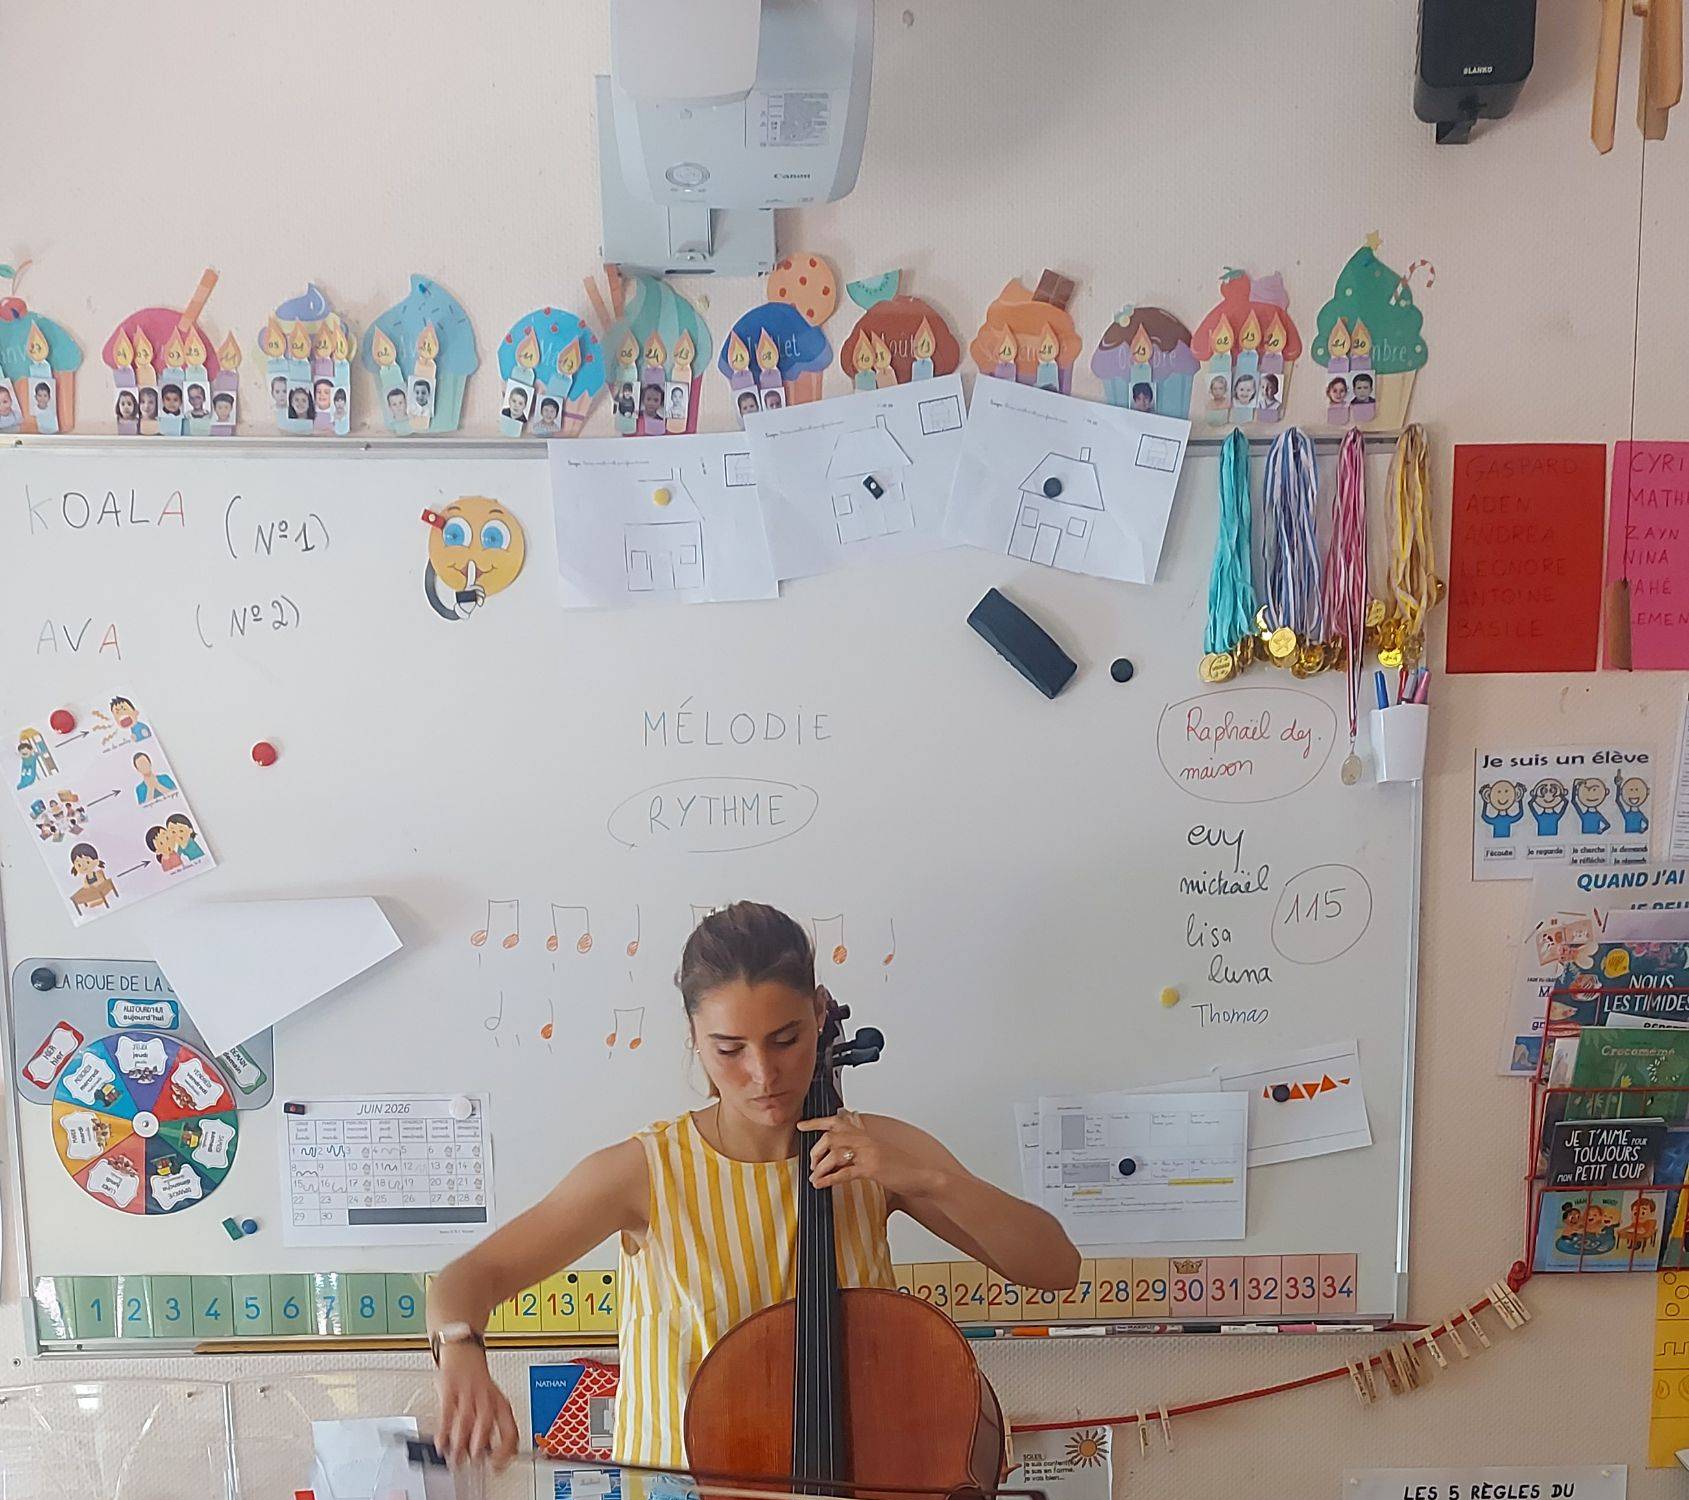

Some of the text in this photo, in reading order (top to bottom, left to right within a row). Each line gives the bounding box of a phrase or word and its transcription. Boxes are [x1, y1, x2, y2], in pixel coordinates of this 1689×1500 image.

[25, 484, 184, 534] KOALA
[1625, 525, 1680, 540] ZAYN
[36, 617, 121, 661] AVA
[644, 696, 832, 747] MÉLODIE
[1187, 706, 1270, 752] Raphaël
[1180, 758, 1253, 780] maison
[1482, 750, 1649, 768] Je suis un élève
[649, 793, 786, 834] RYTHME
[1577, 870, 1685, 891] QUAND J'AI
[1284, 888, 1346, 924] 115
[1207, 954, 1273, 984] luna
[76, 974, 114, 991] ROUE
[120, 976, 139, 991] DE
[144, 977, 163, 991] LA
[1629, 974, 1675, 989] NOUS
[1604, 995, 1631, 1012] LES
[1191, 1003, 1269, 1027] Thomas
[357, 1103, 411, 1115] JUIN 2026
[1565, 1129, 1580, 1147] JE
[1589, 1129, 1631, 1146] T'AIME
[1574, 1146, 1641, 1164] TOUJOURS
[1574, 1164, 1607, 1182] PETIT
[1612, 1163, 1645, 1179] LOUP
[90, 1298, 102, 1322] 1
[127, 1299, 142, 1322] 2
[165, 1298, 182, 1322] 3
[205, 1297, 221, 1321] 4
[244, 1296, 260, 1320] 5
[283, 1296, 300, 1320] 6
[359, 1295, 376, 1318] 8
[398, 1294, 415, 1318] 9
[508, 1291, 538, 1317] 12
[546, 1293, 575, 1316] 13
[584, 1292, 613, 1316] 14
[917, 1284, 948, 1307] 23
[954, 1282, 985, 1306] 24
[988, 1283, 1019, 1306] 25
[1025, 1286, 1056, 1305] 26
[1062, 1281, 1092, 1304] 27
[1099, 1280, 1130, 1303] 28
[1135, 1278, 1167, 1302] 29
[1172, 1278, 1204, 1302] 30
[1211, 1278, 1239, 1301] 31
[1247, 1277, 1279, 1301] 32
[1284, 1276, 1316, 1300] 33
[1322, 1275, 1353, 1299] 34
[535, 1380, 567, 1388] NATHAN
[1403, 1482, 1575, 1500] LES 5 RÈGLES DU
